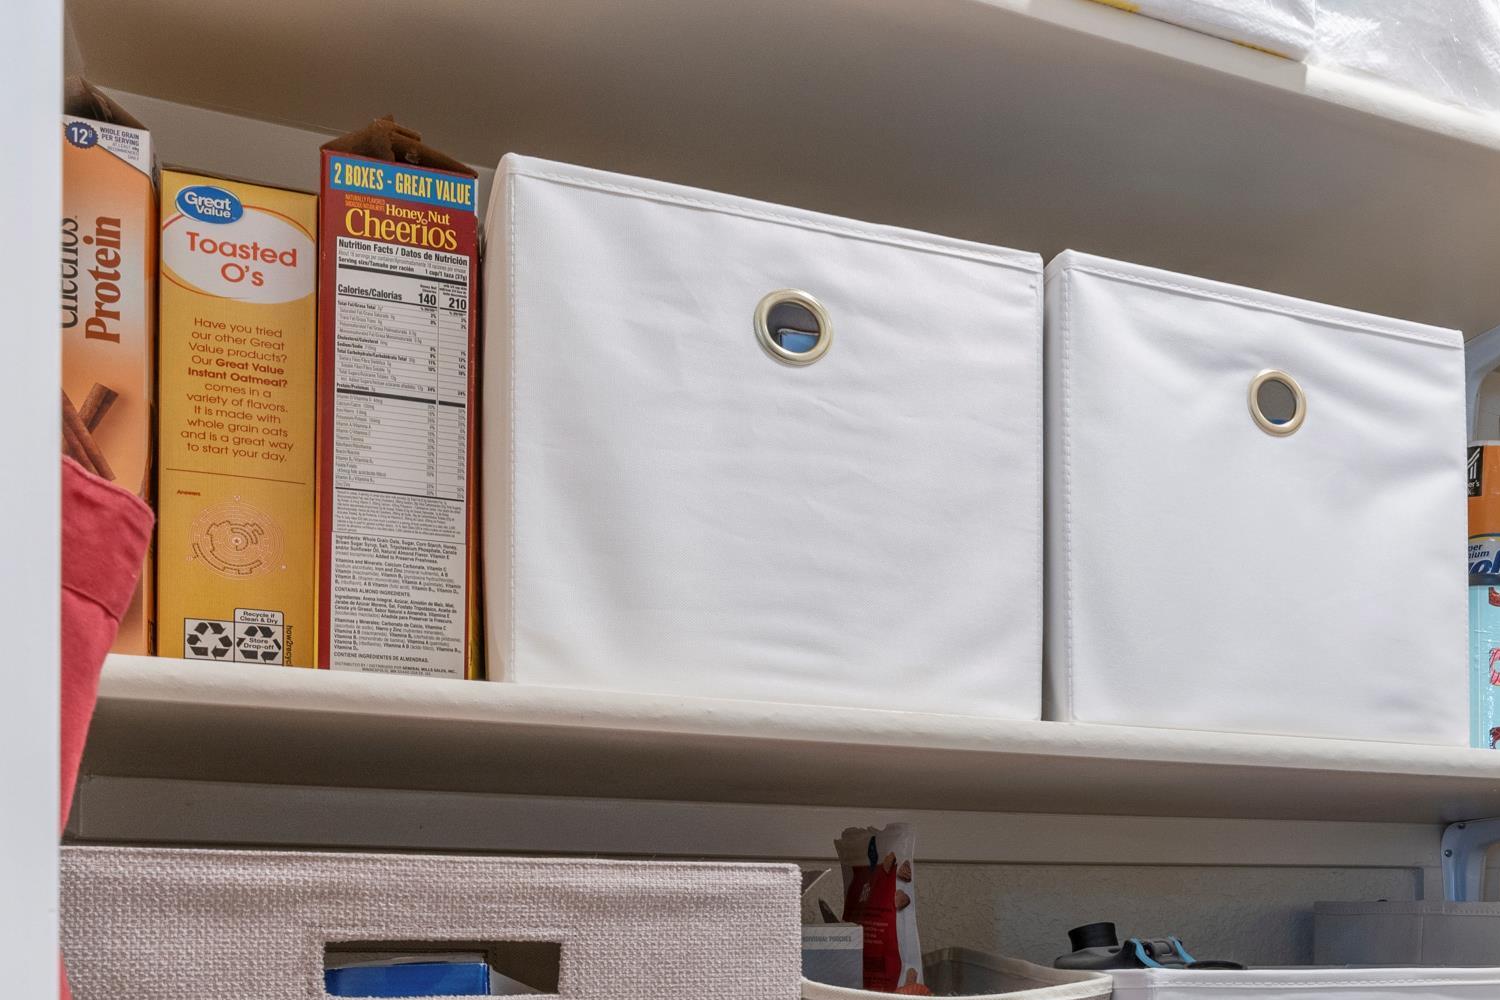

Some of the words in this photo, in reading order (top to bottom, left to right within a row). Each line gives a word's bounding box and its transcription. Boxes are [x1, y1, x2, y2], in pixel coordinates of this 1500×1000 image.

[99, 127, 120, 137] WHOLE
[121, 130, 140, 140] GRAIN
[101, 133, 113, 141] PER
[114, 135, 140, 147] SERVING
[334, 162, 341, 184] 2
[345, 164, 384, 191] BOXES
[395, 173, 433, 199] GREAT
[435, 180, 471, 205] VALUE
[184, 191, 232, 211] Great
[195, 205, 231, 218] Value
[386, 204, 424, 224] Honey
[428, 210, 450, 225] Nut
[345, 207, 458, 251] Cheerios
[186, 231, 297, 268] Toasted
[338, 239, 371, 251] Nutrition
[373, 243, 393, 254] Facts
[400, 248, 422, 259] Datos
[423, 252, 433, 261] de
[434, 253, 468, 266] Nutrición
[338, 256, 357, 265] Serving
[82, 216, 122, 344] Protein
[418, 293, 437, 306] 140
[449, 297, 467, 310] 210
[194, 317, 226, 330] Have
[230, 323, 252, 334] you
[255, 325, 283, 338] tried
[191, 331, 211, 340] our
[214, 333, 246, 345] other
[250, 337, 285, 351] Great
[188, 342, 224, 355] Value
[227, 348, 288, 363] products?
[191, 354, 213, 366] Our
[215, 358, 249, 370] Great
[251, 362, 284, 376] Value
[187, 367, 227, 380] Instant
[230, 372, 288, 388] Oatmeal?
[204, 383, 246, 395] comes
[249, 386, 259, 396] in
[262, 390, 272, 398] a
[186, 393, 228, 407] variety
[231, 398, 244, 407] of
[247, 399, 288, 413] flavors.
[194, 405, 202, 415] It
[204, 406, 213, 416] is
[215, 408, 253, 421] made
[256, 413, 281, 424] with
[187, 417, 225, 429] whole
[228, 423, 259, 434] grain
[262, 426, 289, 438] oats
[180, 430, 206, 441] and
[209, 432, 218, 441] is
[220, 434, 229, 443] a
[232, 436, 265, 447] great
[268, 440, 294, 451] way
[187, 442, 199, 452] to
[202, 443, 229, 455] start
[232, 448, 258, 458] your
[261, 451, 288, 463] day.
[243, 642, 274, 650] Drop-off
